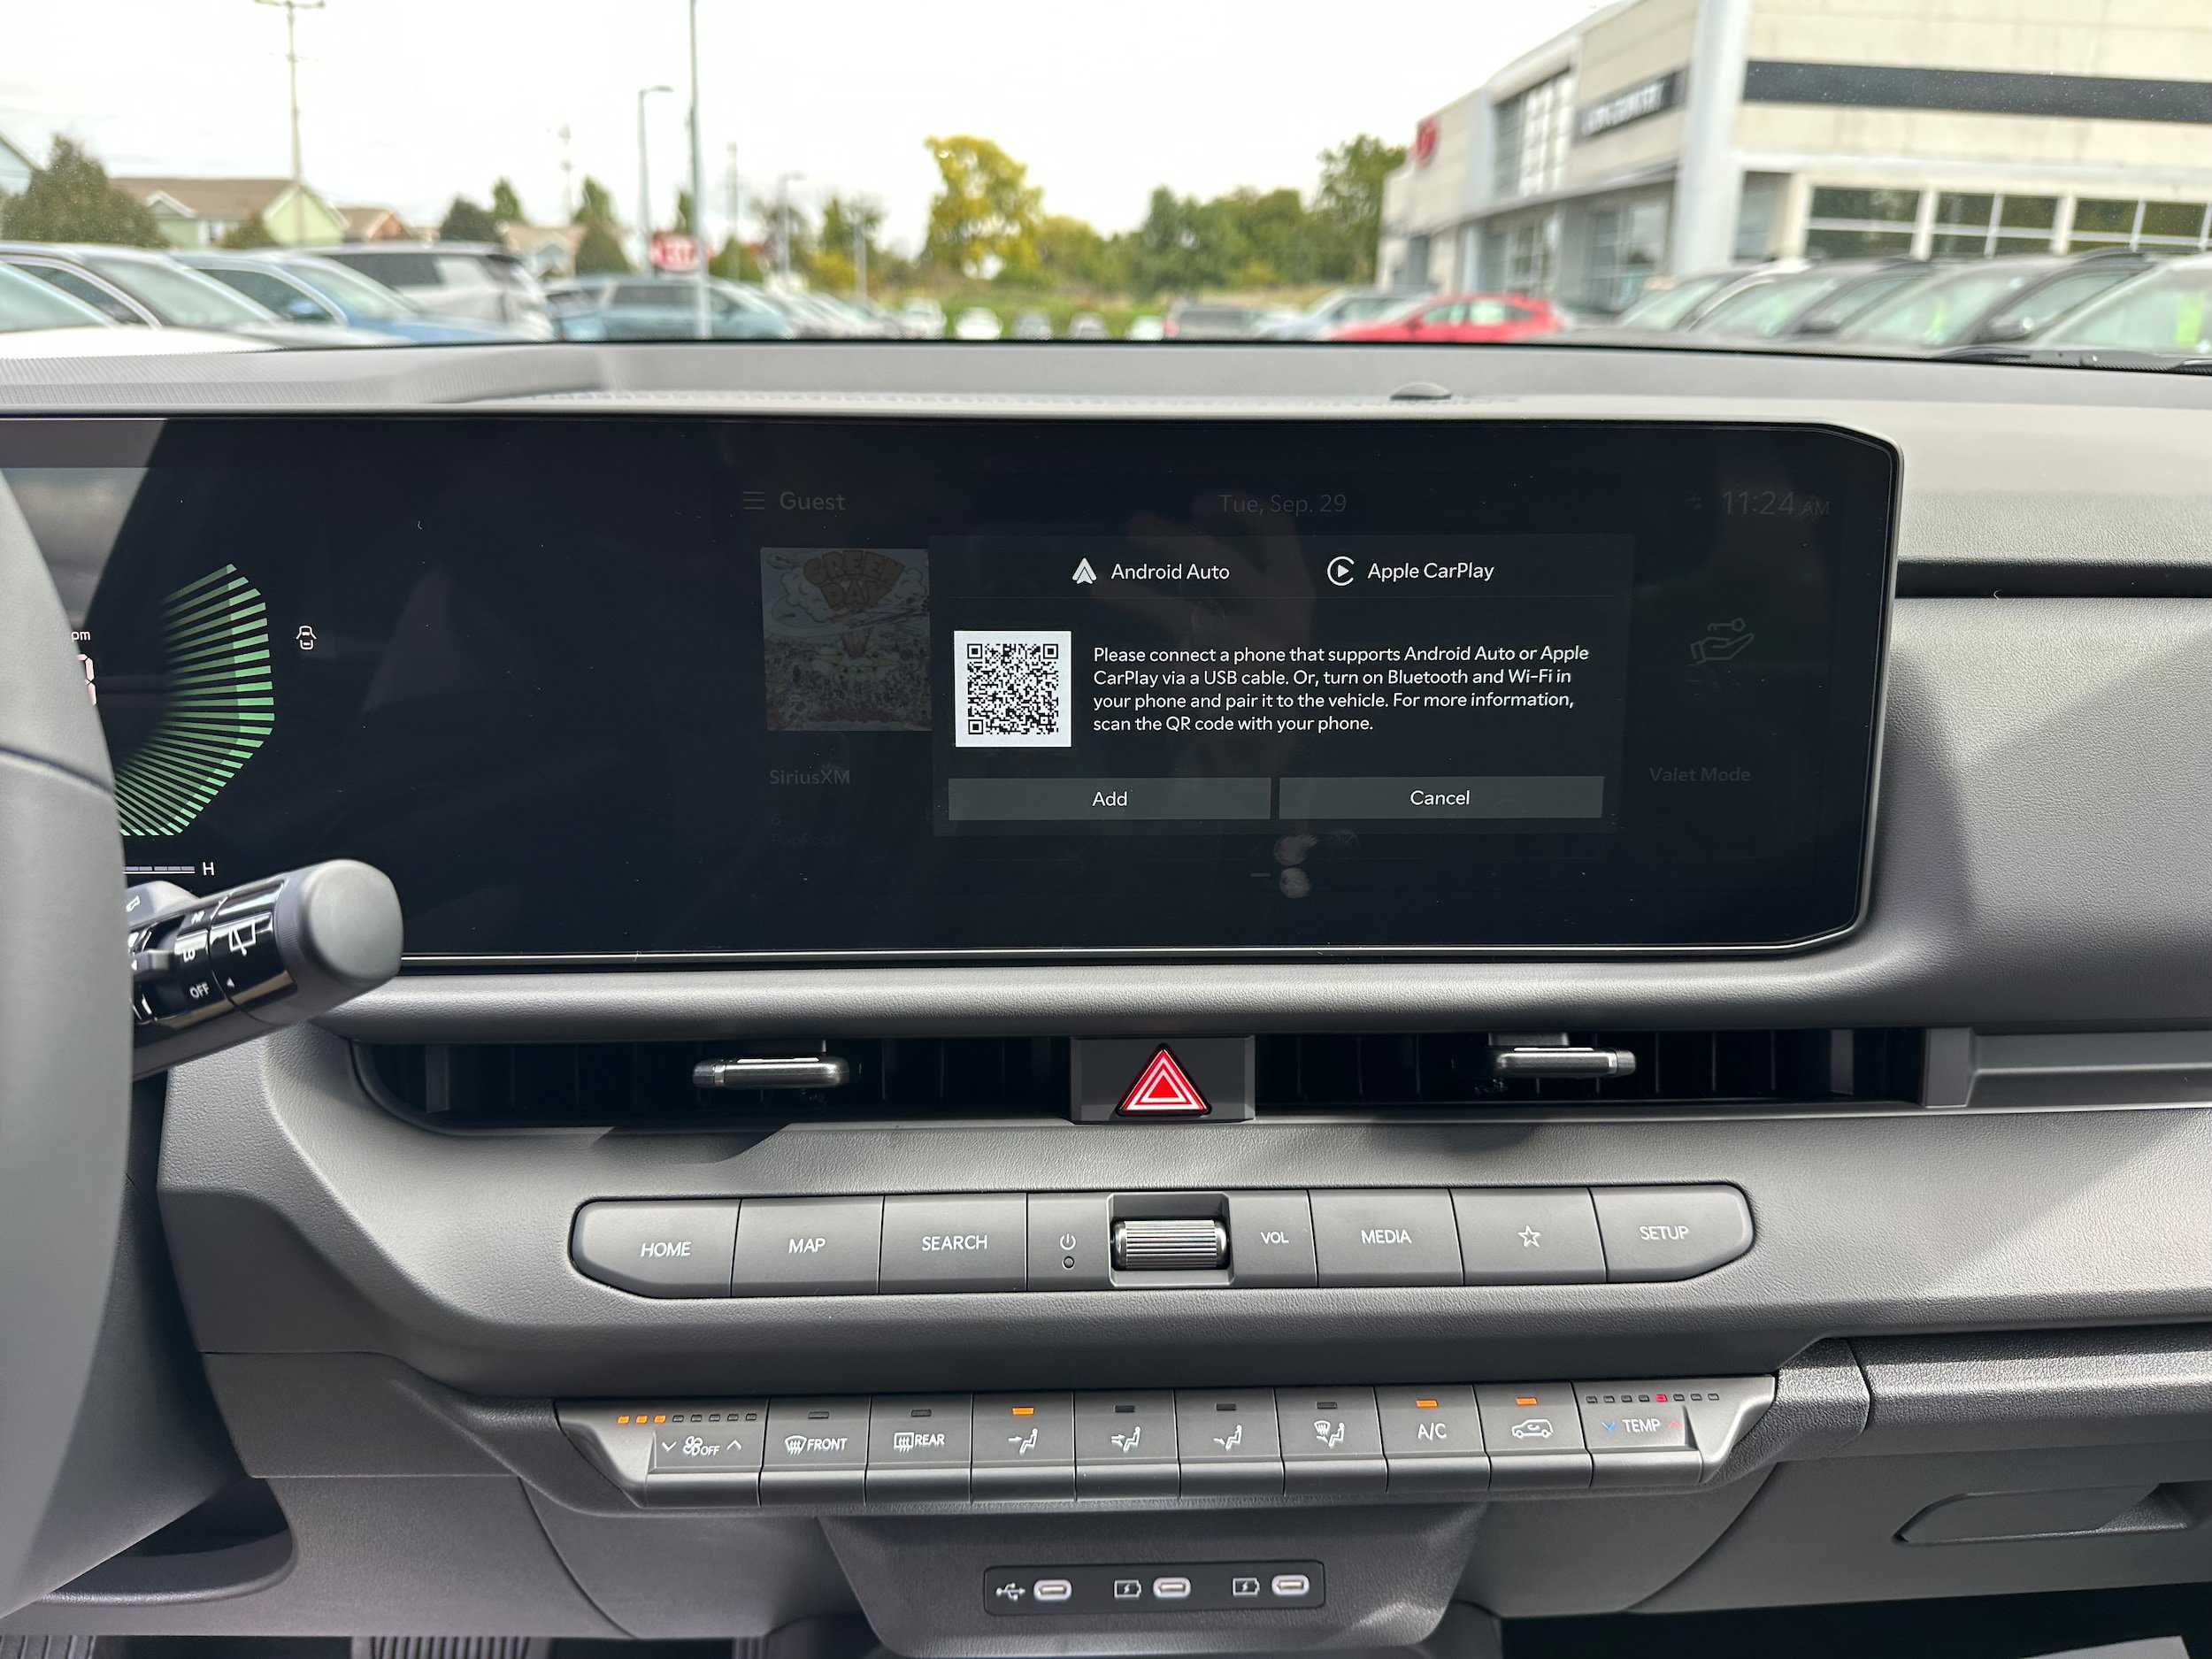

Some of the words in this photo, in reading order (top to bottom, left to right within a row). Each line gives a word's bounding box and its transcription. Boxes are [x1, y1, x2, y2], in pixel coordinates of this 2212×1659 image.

[780, 491, 846, 510] Guest
[1218, 495, 1263, 516] Tue,
[1270, 495, 1313, 517] Sep.
[1320, 495, 1347, 512] 29
[1723, 491, 1795, 515] 11:24
[1801, 501, 1830, 515] AM
[803, 550, 905, 586] GREEN
[1111, 564, 1181, 579] Android
[1187, 564, 1229, 579] Auto
[1368, 563, 1419, 582] Apple
[1424, 563, 1494, 581] CarPlay
[820, 580, 892, 608] DAY
[1094, 648, 1145, 661] Please
[1150, 649, 1216, 661] connect
[1220, 651, 1229, 661] a
[1234, 647, 1285, 664] phone
[1289, 647, 1325, 661] that
[1328, 649, 1400, 664] supports
[1404, 646, 1471, 660] Android
[1474, 646, 1515, 660] Auto
[1519, 649, 1537, 660] or
[1540, 645, 1588, 663] Apple
[1094, 671, 1158, 687] CarPlay
[1163, 671, 1185, 684] via
[1190, 674, 1199, 684] a
[1205, 671, 1237, 684] USB
[1242, 671, 1288, 684] cable.
[1294, 670, 1318, 687] Or,
[1324, 672, 1358, 684] turn
[1363, 674, 1383, 684] on
[1388, 669, 1468, 684] Bluetooth
[1473, 669, 1503, 683] and
[1509, 669, 1552, 683] Wi-Fi
[1557, 670, 1571, 682] in
[1094, 698, 1131, 710] your
[1135, 694, 1186, 710] phone
[1191, 694, 1221, 707] and
[1226, 694, 1258, 710] pair
[1263, 694, 1273, 707] it
[1277, 695, 1294, 707] to
[1297, 693, 1325, 707] the
[1329, 693, 1388, 707] vehicle.
[1394, 693, 1420, 706] For
[1425, 696, 1467, 706] more
[1471, 692, 1573, 708] information,
[1094, 720, 1130, 731] scan
[1135, 717, 1162, 730] the
[1166, 717, 1190, 732] QR
[1195, 716, 1233, 730] code
[1238, 716, 1272, 730] with
[1277, 720, 1314, 733] your
[1318, 716, 1372, 733] phone.
[769, 770, 850, 785] SiriusXM
[1649, 767, 1697, 781] Valet
[1701, 767, 1751, 781] Mode
[1093, 792, 1126, 806] Add
[1410, 790, 1470, 805] Cancel
[203, 862, 214, 875] H
[189, 982, 210, 998] OFF
[1261, 1232, 1289, 1244] VOL
[1361, 1230, 1411, 1243] MEDIA
[1640, 1226, 1689, 1240] SETUP
[641, 1242, 691, 1256] HOME
[789, 1238, 826, 1253] MAP
[922, 1235, 987, 1250] SEARCH
[1418, 1423, 1447, 1440] A/C
[1622, 1418, 1661, 1432] TEMP
[807, 1439, 848, 1451] FRONT
[915, 1434, 944, 1447] REAR
[701, 1446, 719, 1455] OFF
